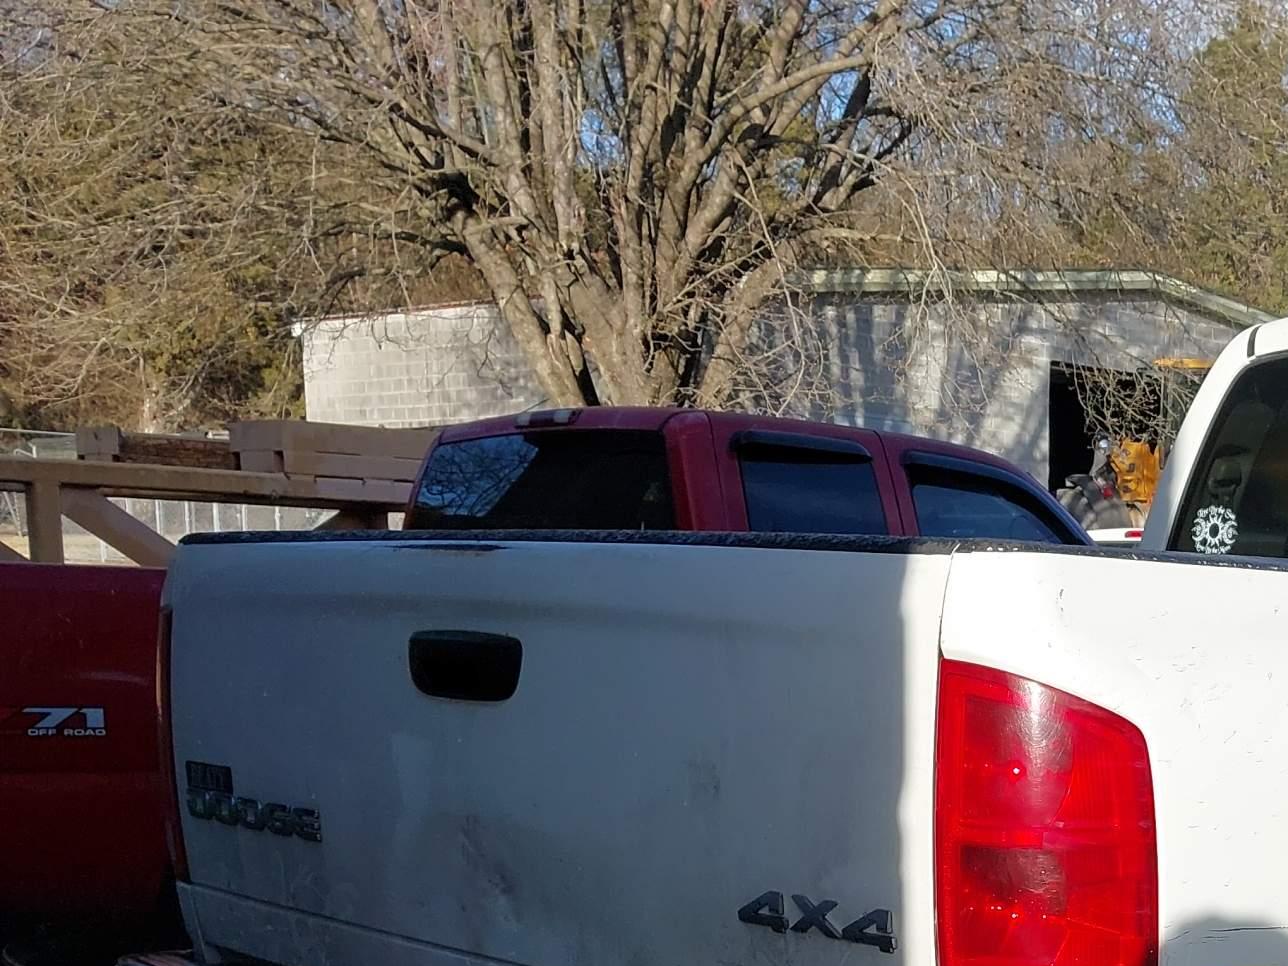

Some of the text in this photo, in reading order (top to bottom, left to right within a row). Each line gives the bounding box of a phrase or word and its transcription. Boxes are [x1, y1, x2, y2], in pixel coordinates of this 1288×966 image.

[27, 728, 107, 736] OFF ROAD
[185, 788, 322, 843] DODGE
